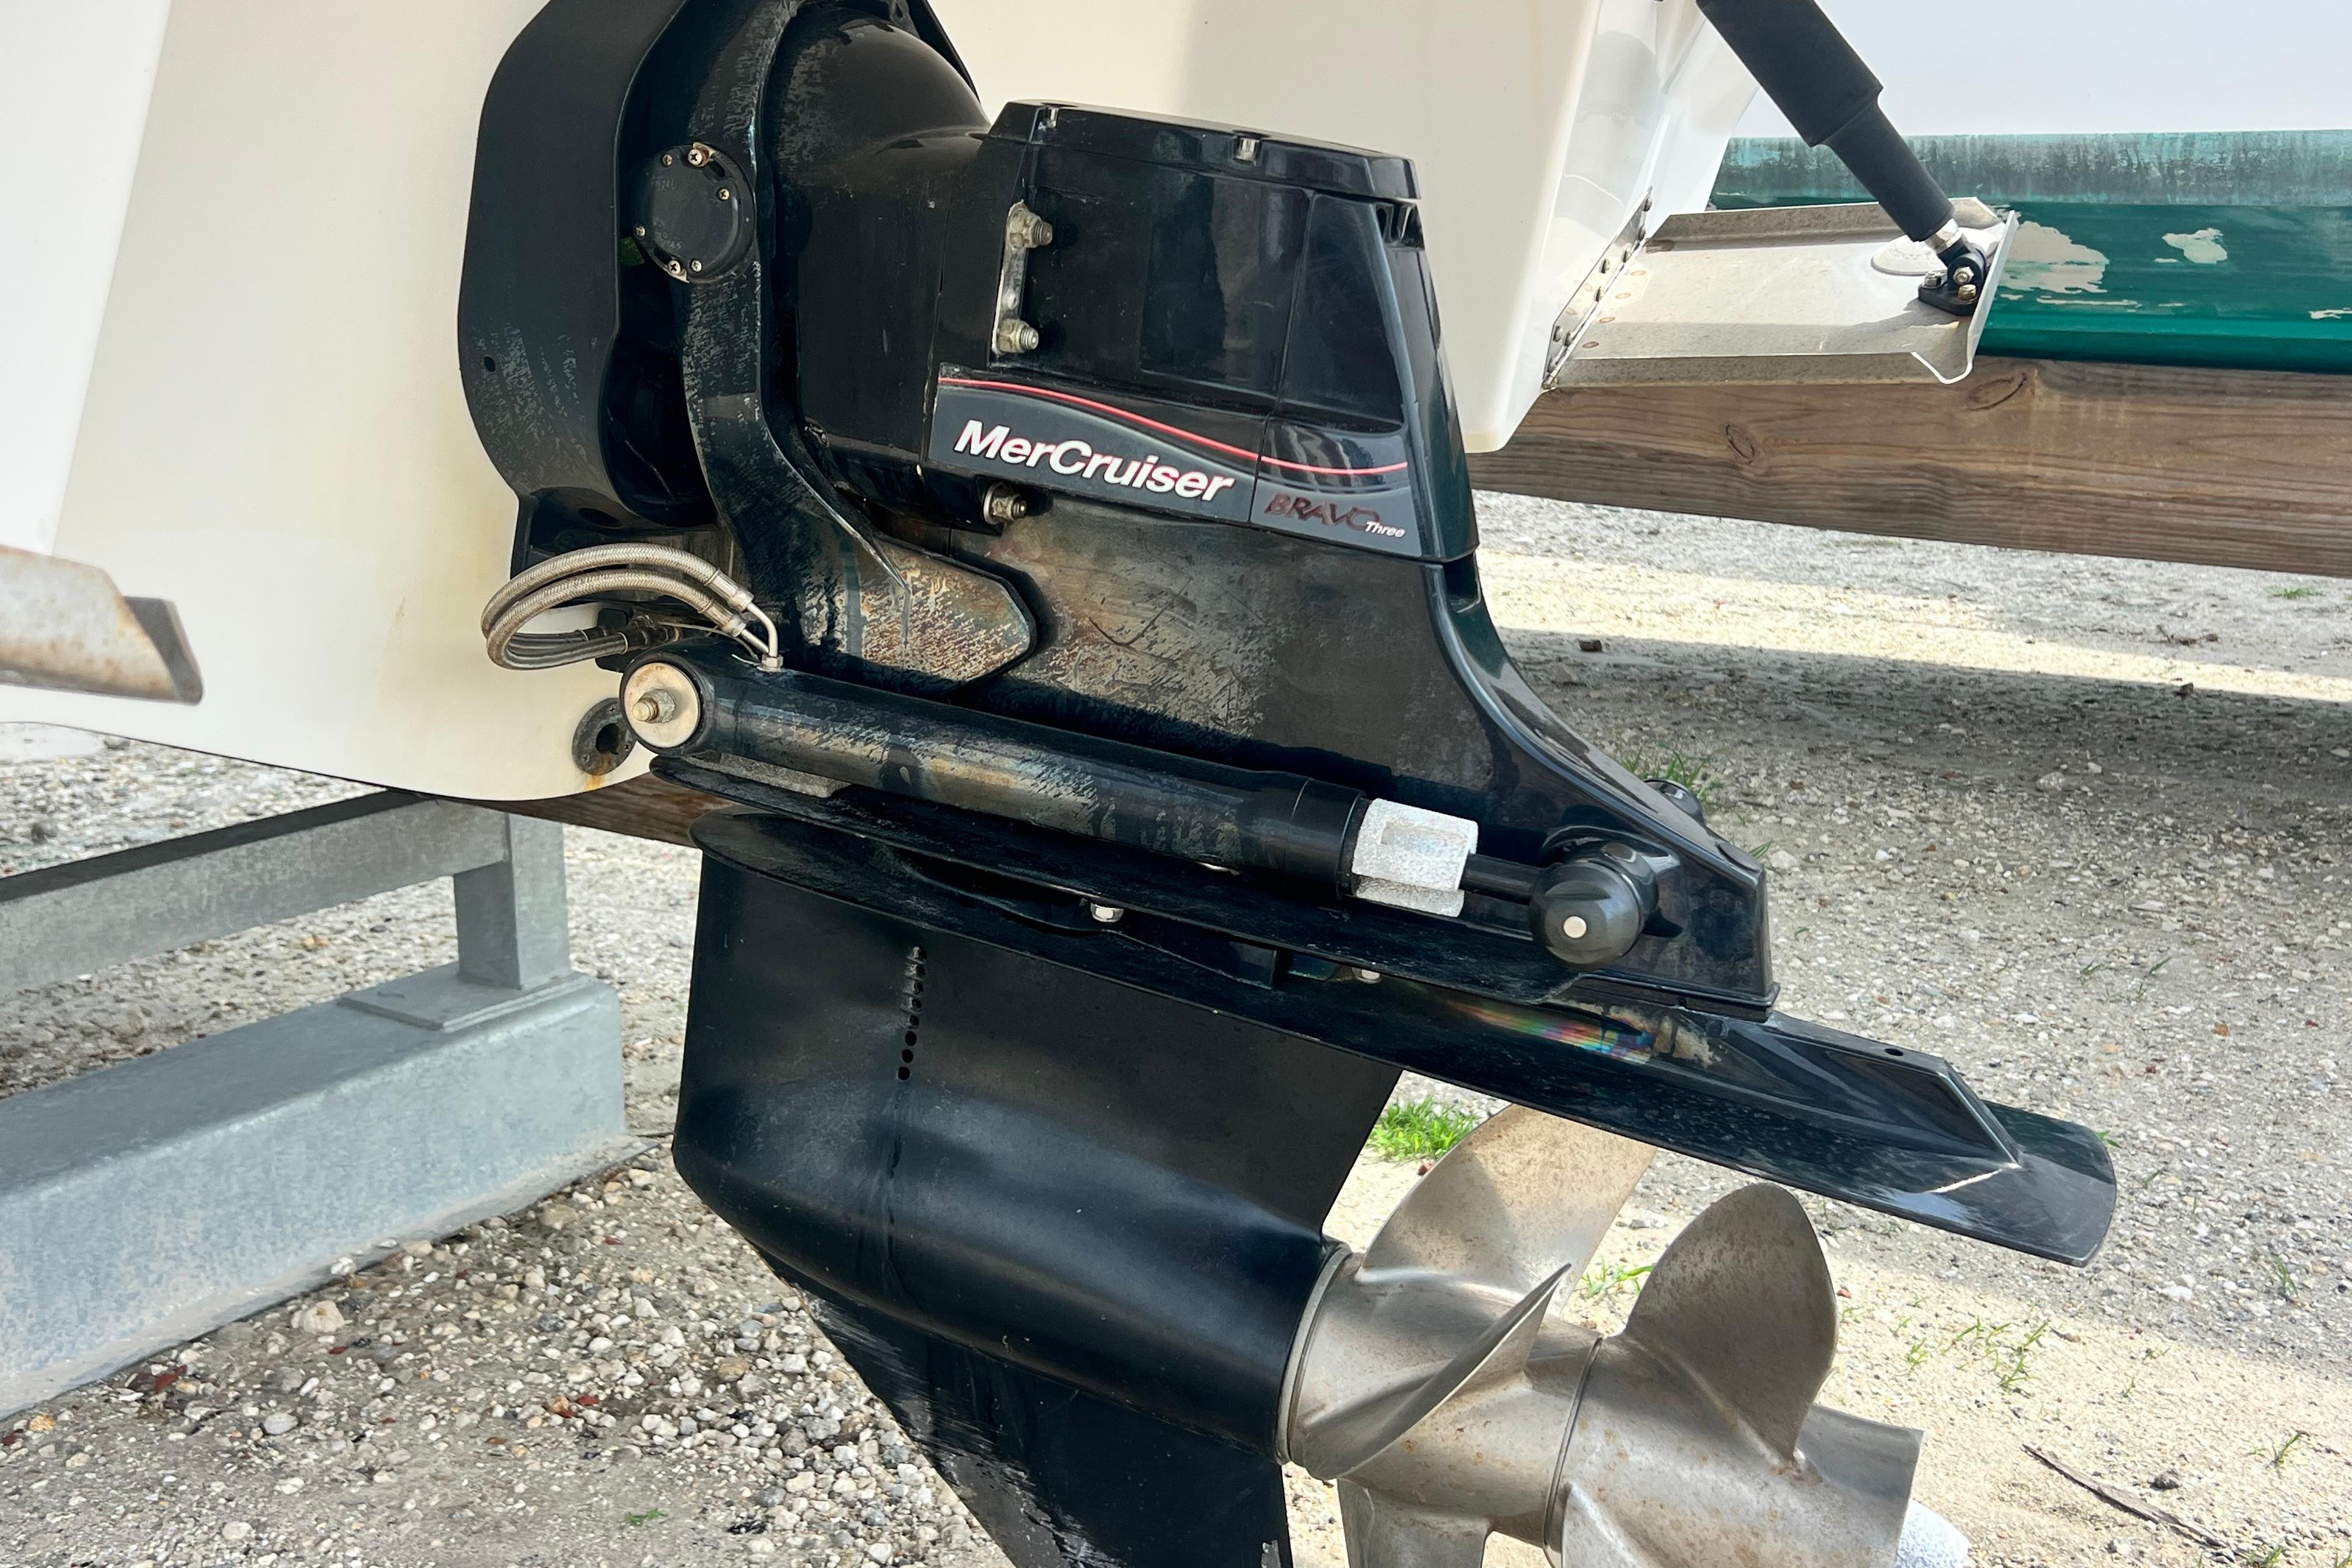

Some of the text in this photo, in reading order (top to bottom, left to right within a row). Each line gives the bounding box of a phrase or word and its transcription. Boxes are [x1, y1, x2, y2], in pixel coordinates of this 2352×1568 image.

[953, 419, 1236, 502] MerCruiser
[1264, 494, 1381, 531] BRAVO
[1365, 520, 1406, 538] Three
